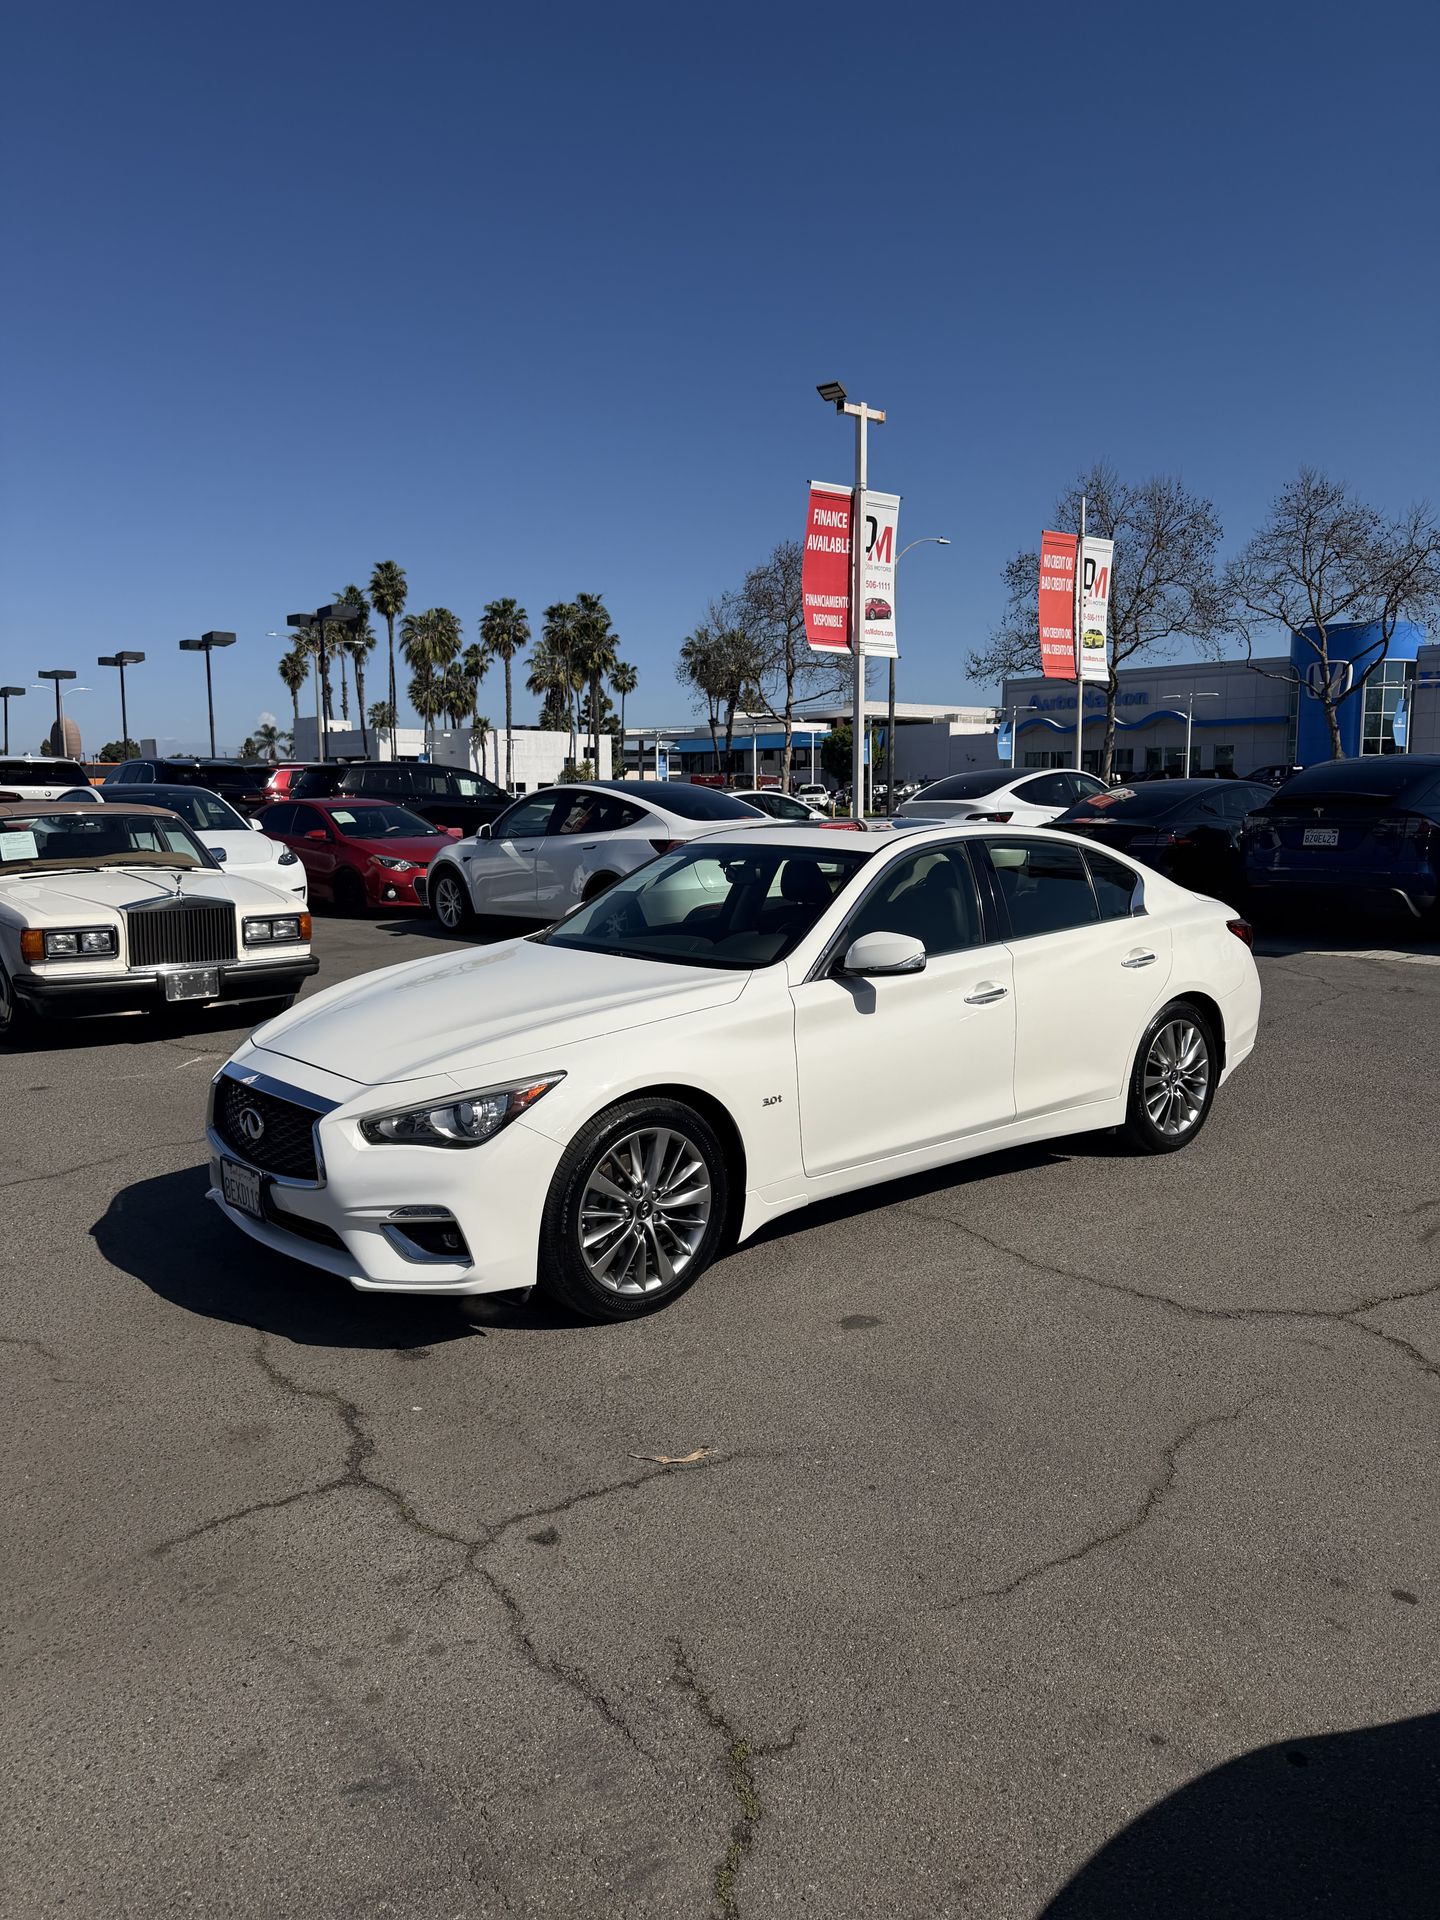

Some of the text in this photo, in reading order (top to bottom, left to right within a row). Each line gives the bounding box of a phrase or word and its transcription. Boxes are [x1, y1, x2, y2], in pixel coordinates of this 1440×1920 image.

[813, 508, 849, 528] FINANCE
[807, 534, 850, 553] AVAILABLE
[805, 593, 849, 609] FINANCIAMIENTO
[813, 613, 843, 628] DISPONIBLE
[1028, 691, 1149, 712] AutoNaion
